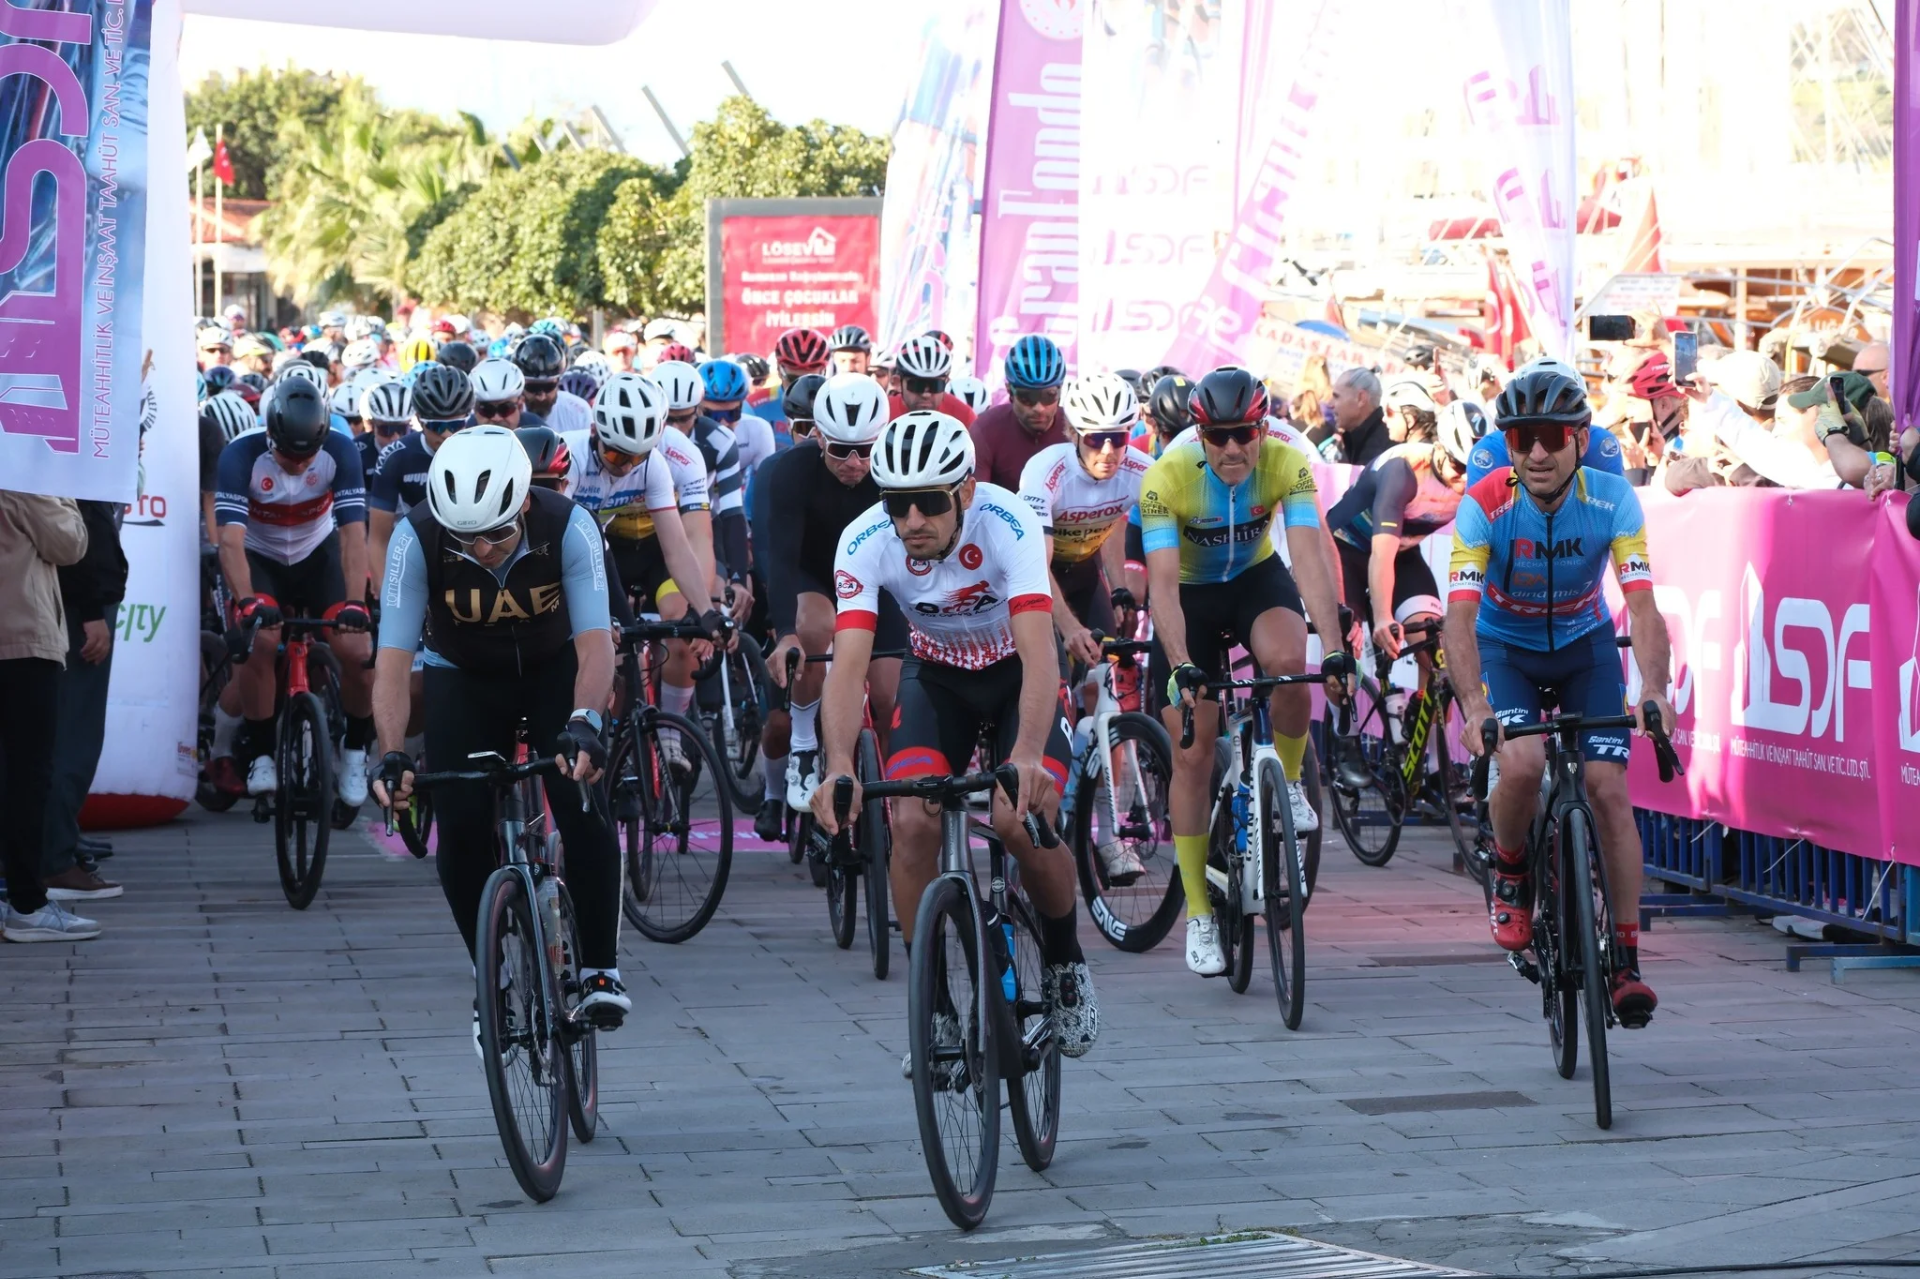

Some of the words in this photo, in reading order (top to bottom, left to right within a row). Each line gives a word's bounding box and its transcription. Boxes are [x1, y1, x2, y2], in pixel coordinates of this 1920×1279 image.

[104, 49, 122, 76] VE
[97, 289, 115, 316] VE
[979, 503, 1025, 541] ORBEA
[1056, 503, 1123, 523] Asperox
[1515, 537, 1584, 559] RMK
[1449, 570, 1485, 584] RMK
[1619, 561, 1651, 575] RMK
[445, 582, 560, 623] UAE
[1587, 735, 1625, 745] Santini
